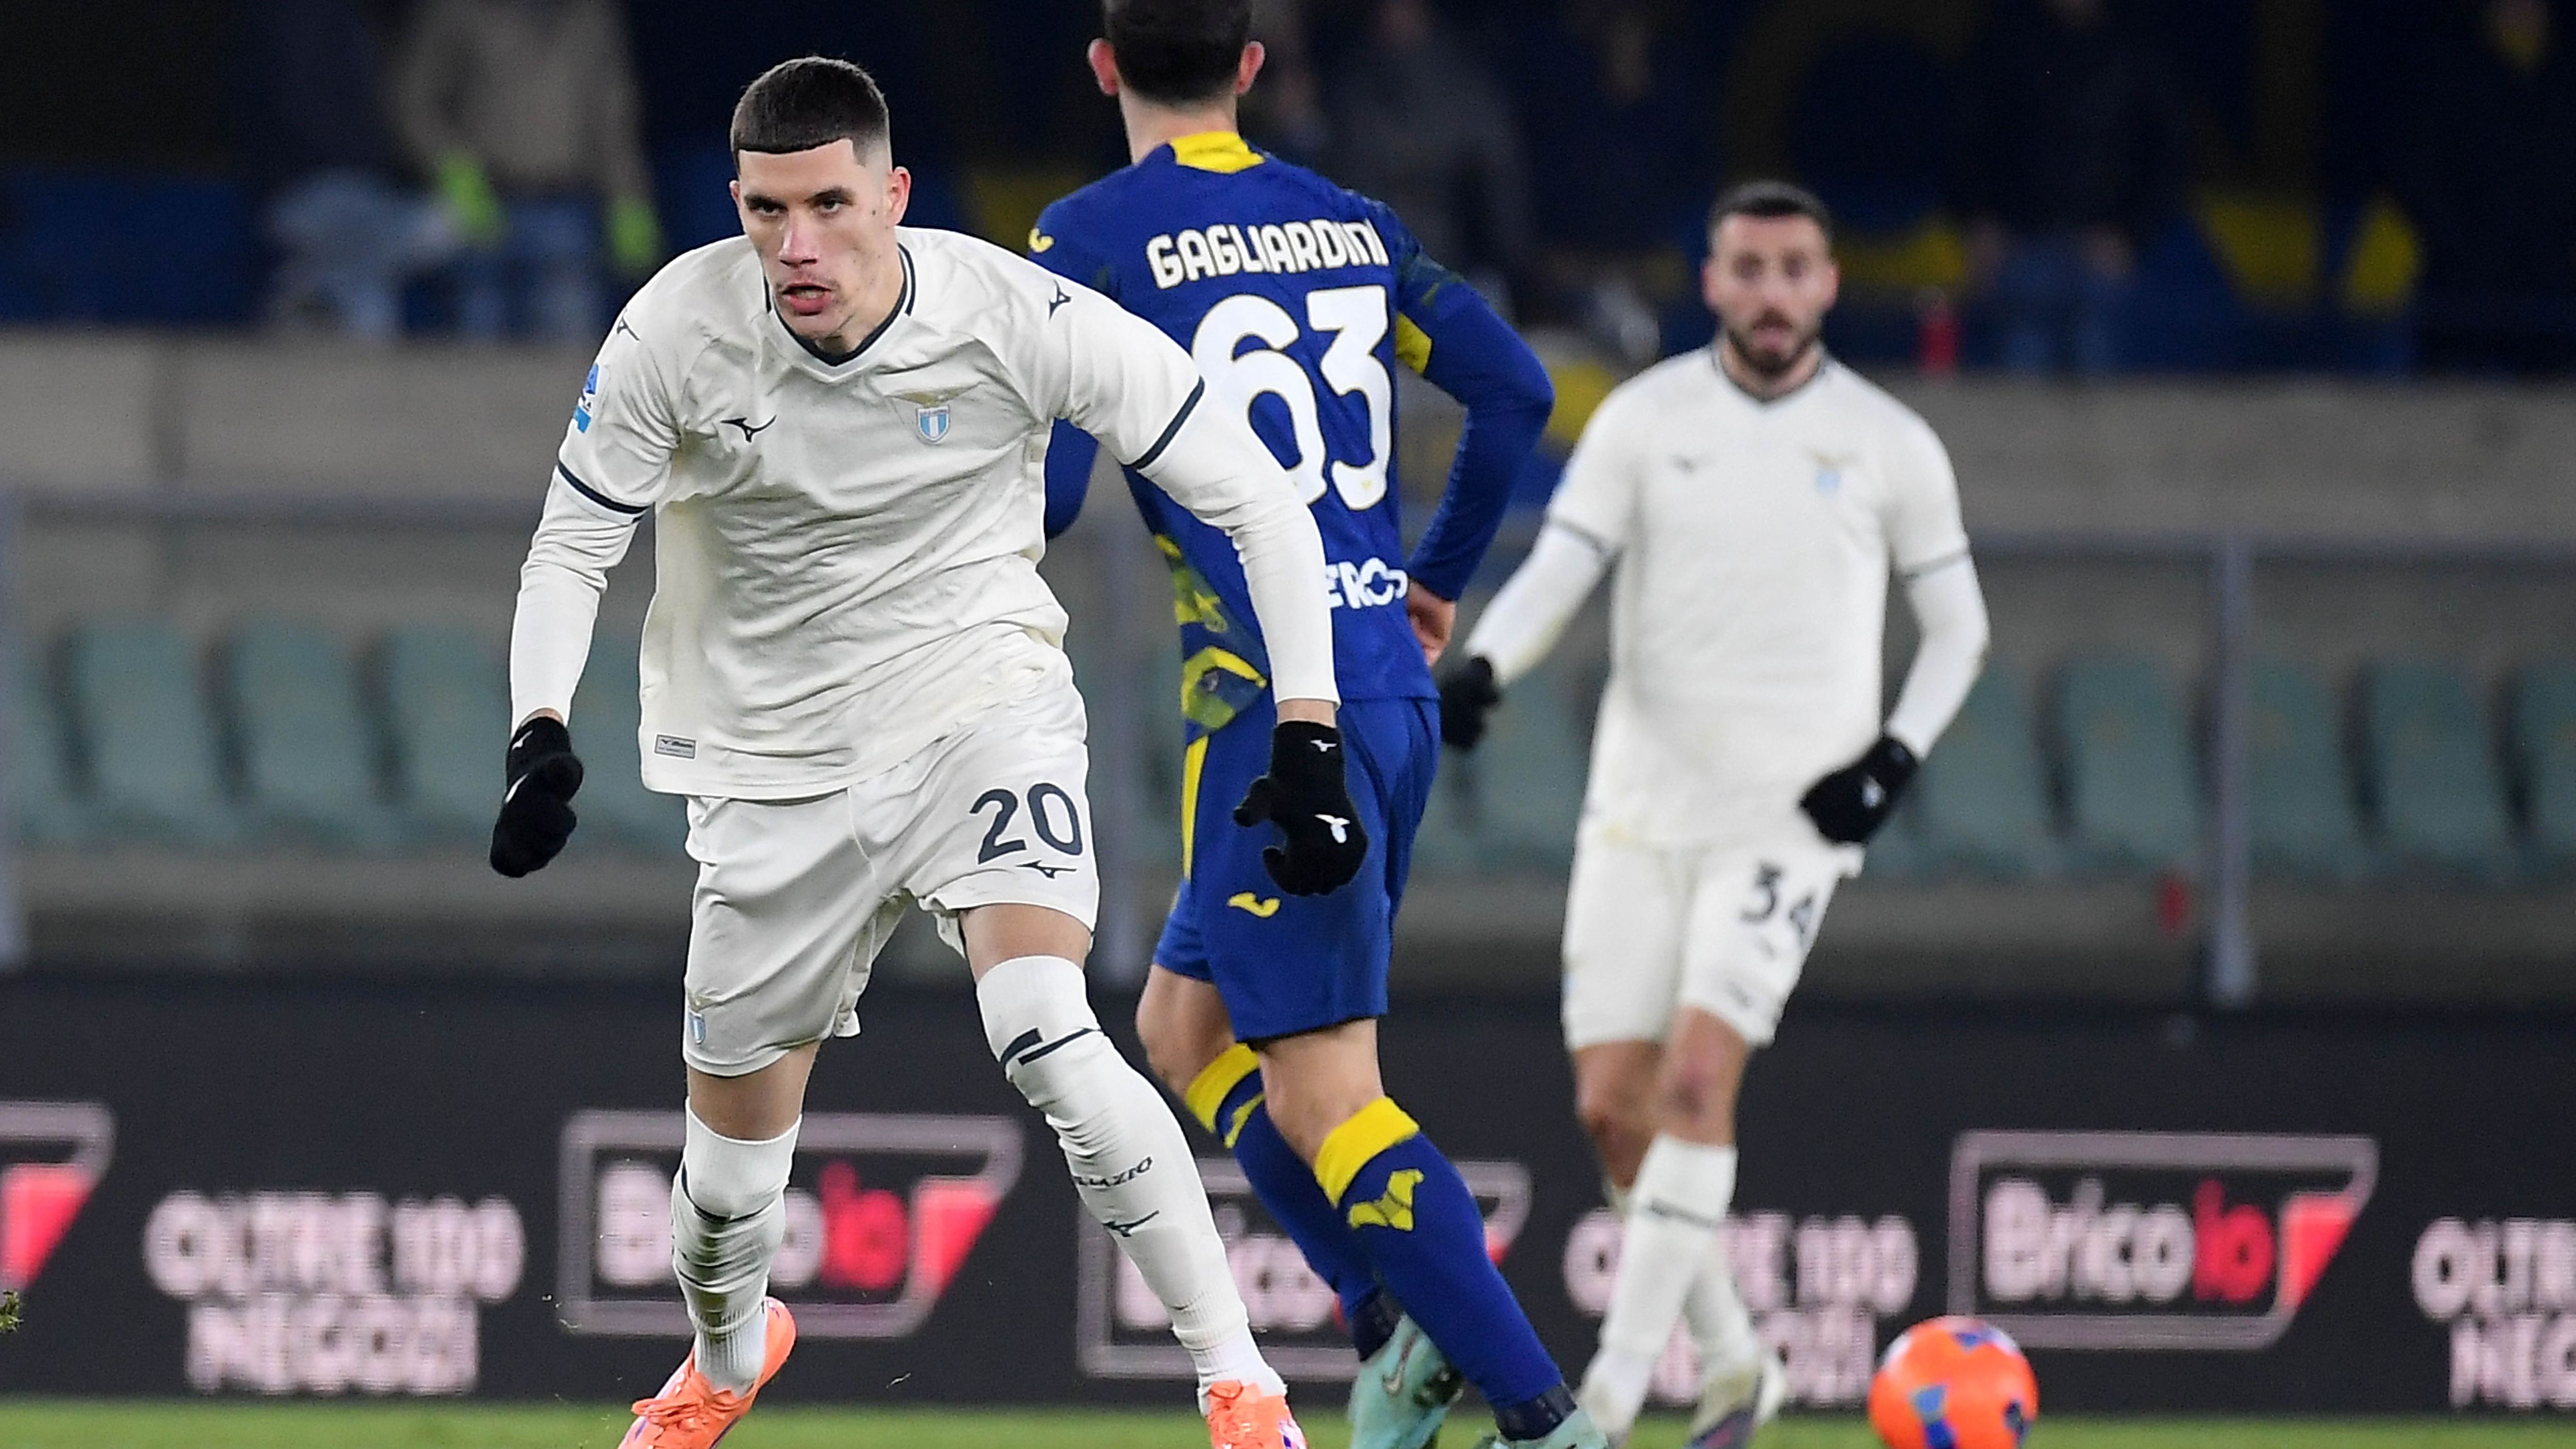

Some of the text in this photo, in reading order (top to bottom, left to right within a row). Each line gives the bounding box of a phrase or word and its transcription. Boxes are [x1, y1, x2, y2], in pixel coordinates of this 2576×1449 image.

[1191, 284, 1392, 511] 63
[970, 782, 1083, 865] 20
[1739, 858, 1817, 948] 34
